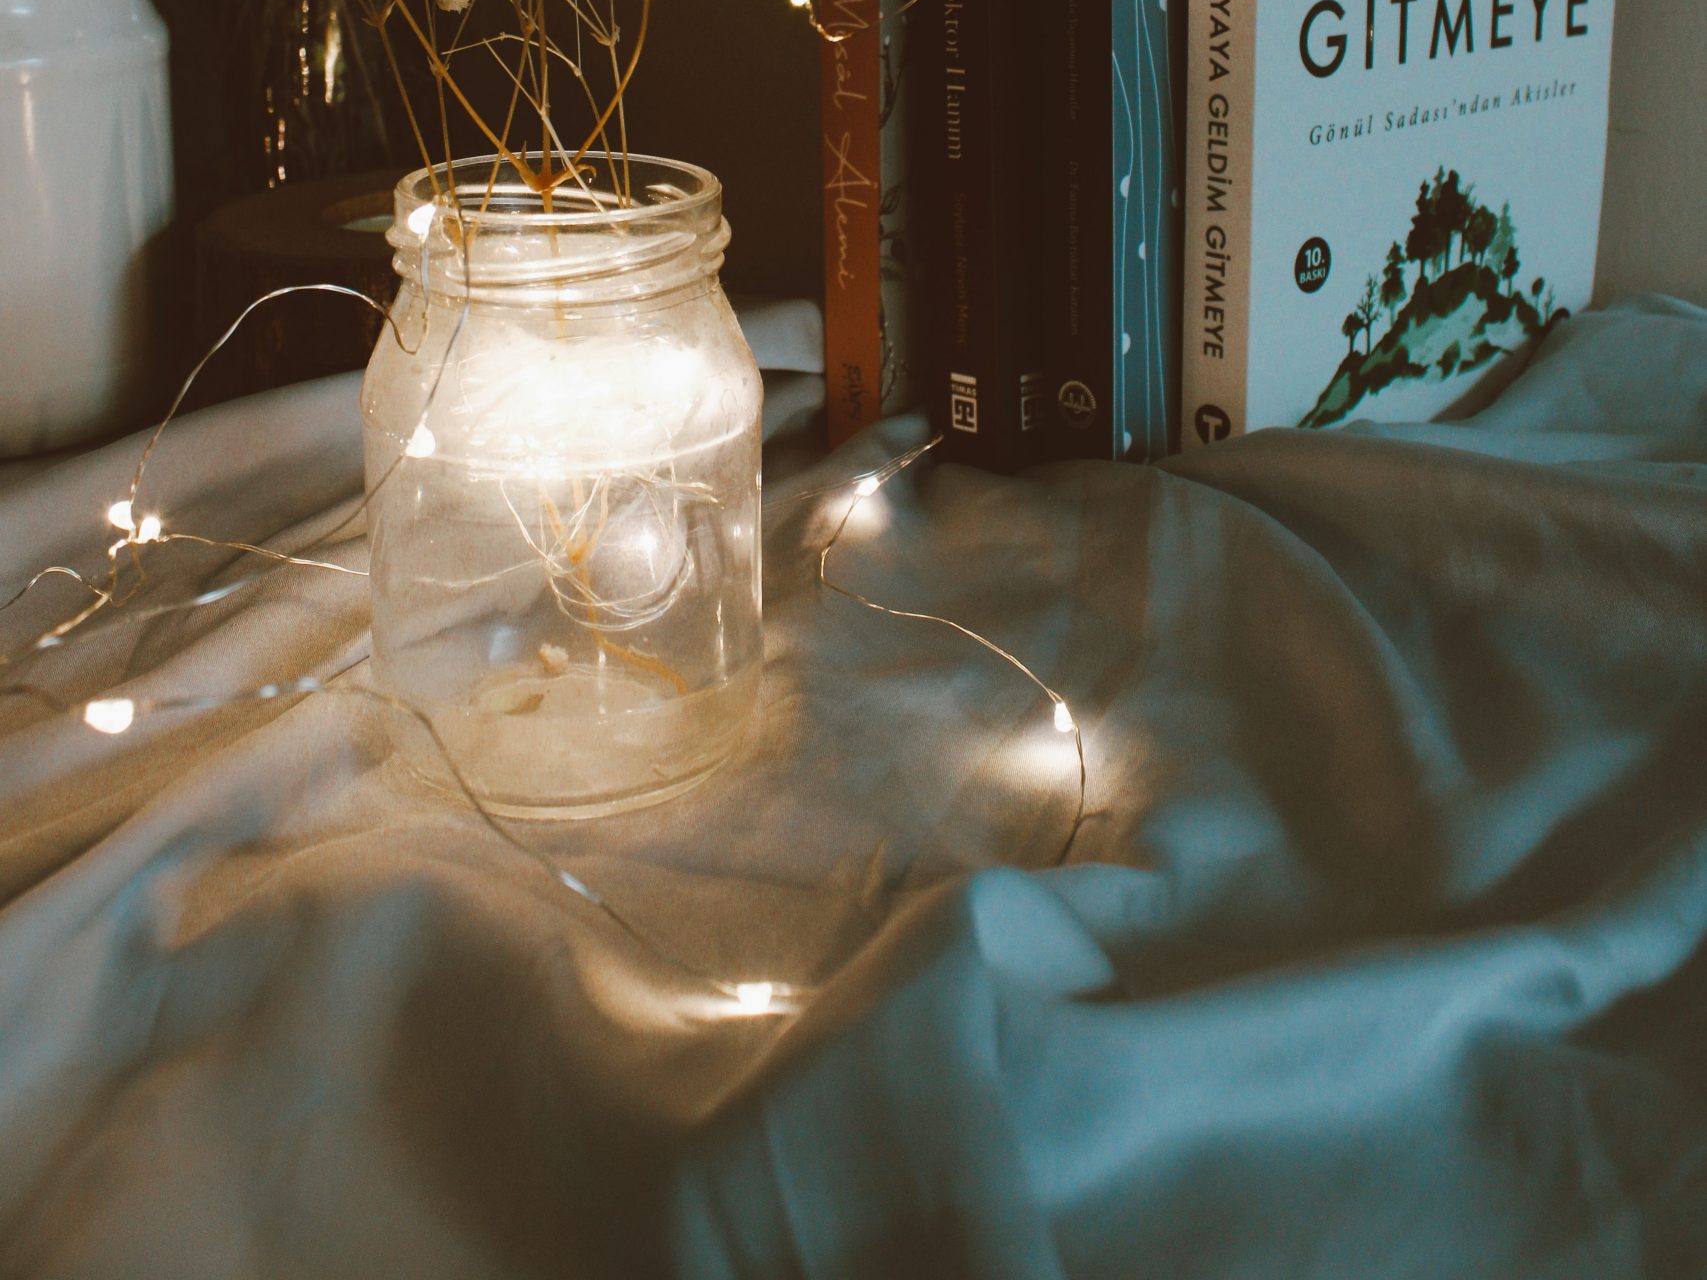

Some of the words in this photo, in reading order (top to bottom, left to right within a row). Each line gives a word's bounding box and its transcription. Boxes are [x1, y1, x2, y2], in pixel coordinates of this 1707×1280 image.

[946, 67, 967, 161] Hanım
[1308, 114, 1374, 146] Gönül
[1383, 93, 1501, 132] Sadası'ndan
[1510, 79, 1577, 107] Akisler
[1207, 93, 1234, 213] GELDİM
[1205, 224, 1232, 360] GİTMEYE
[1299, 267, 1326, 284] BASKI
[1304, 246, 1325, 269] 10.
